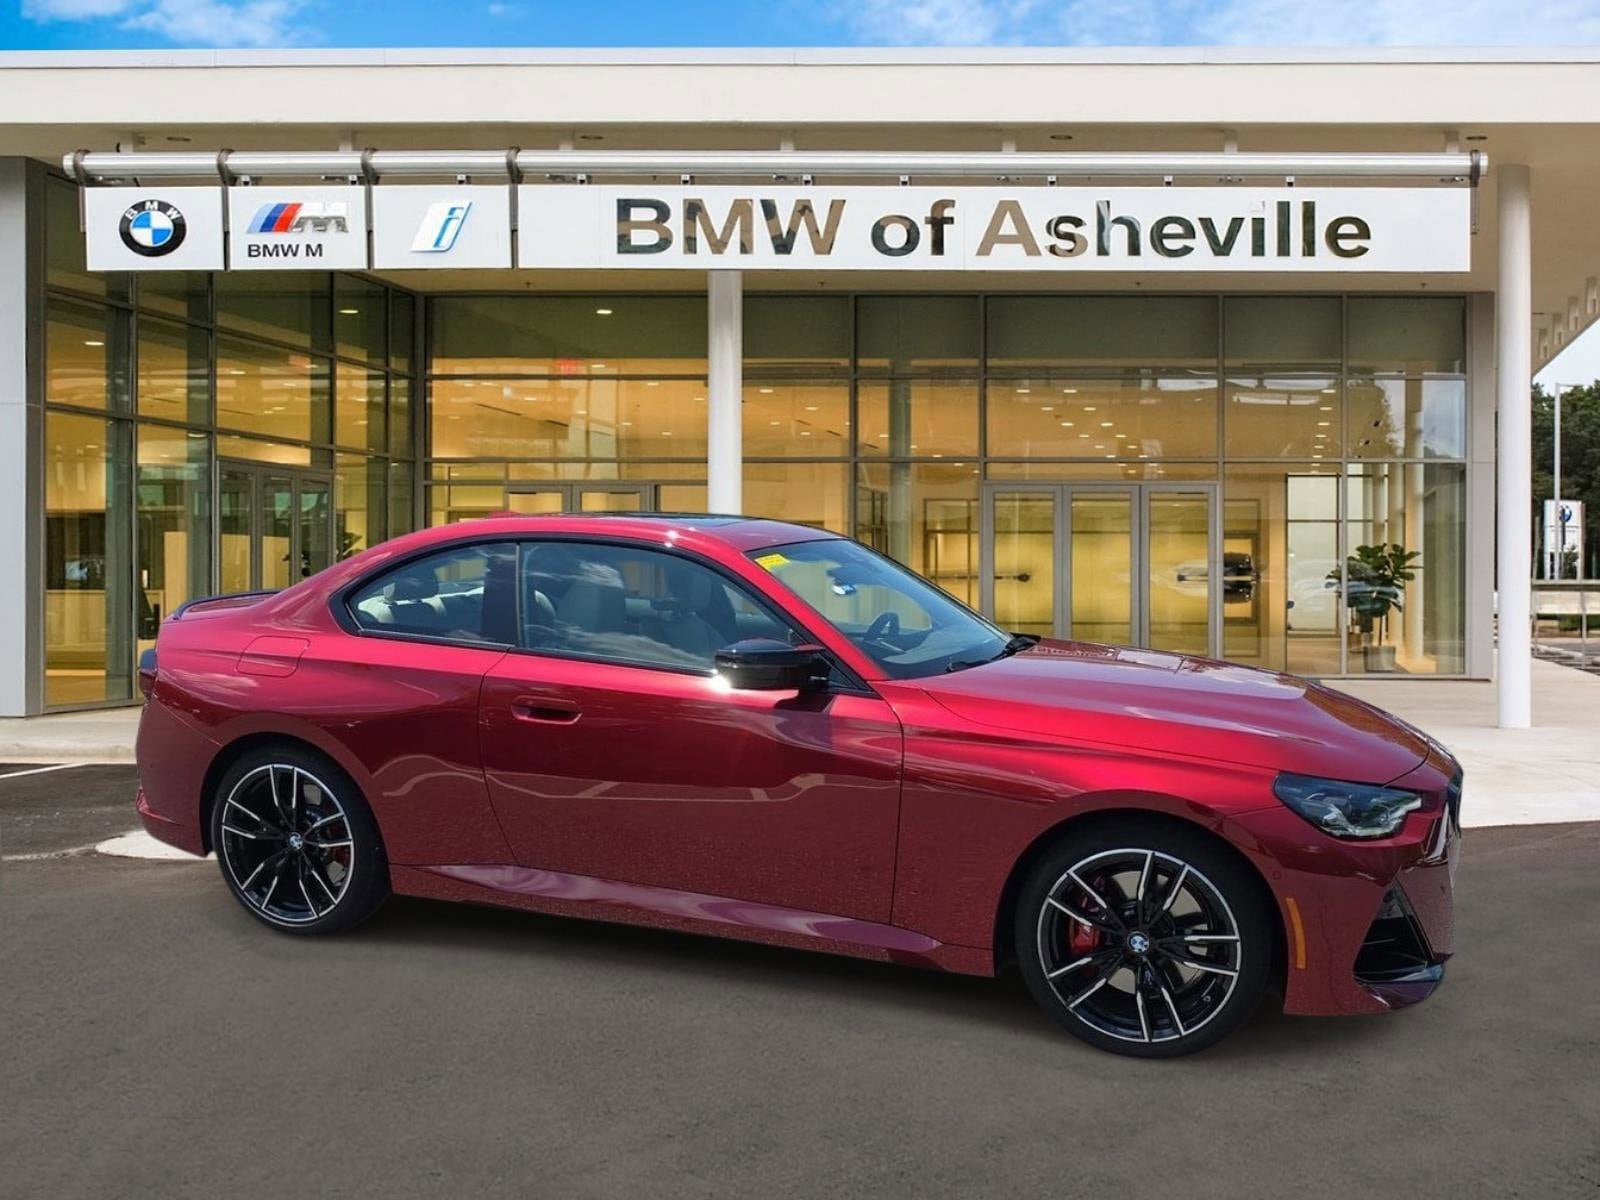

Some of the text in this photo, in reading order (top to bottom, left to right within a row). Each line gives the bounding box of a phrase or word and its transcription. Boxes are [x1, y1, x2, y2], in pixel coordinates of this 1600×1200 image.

[125, 200, 181, 220] BMW
[616, 198, 1372, 258] BMW of Asheville
[247, 243, 323, 258] BMW M
